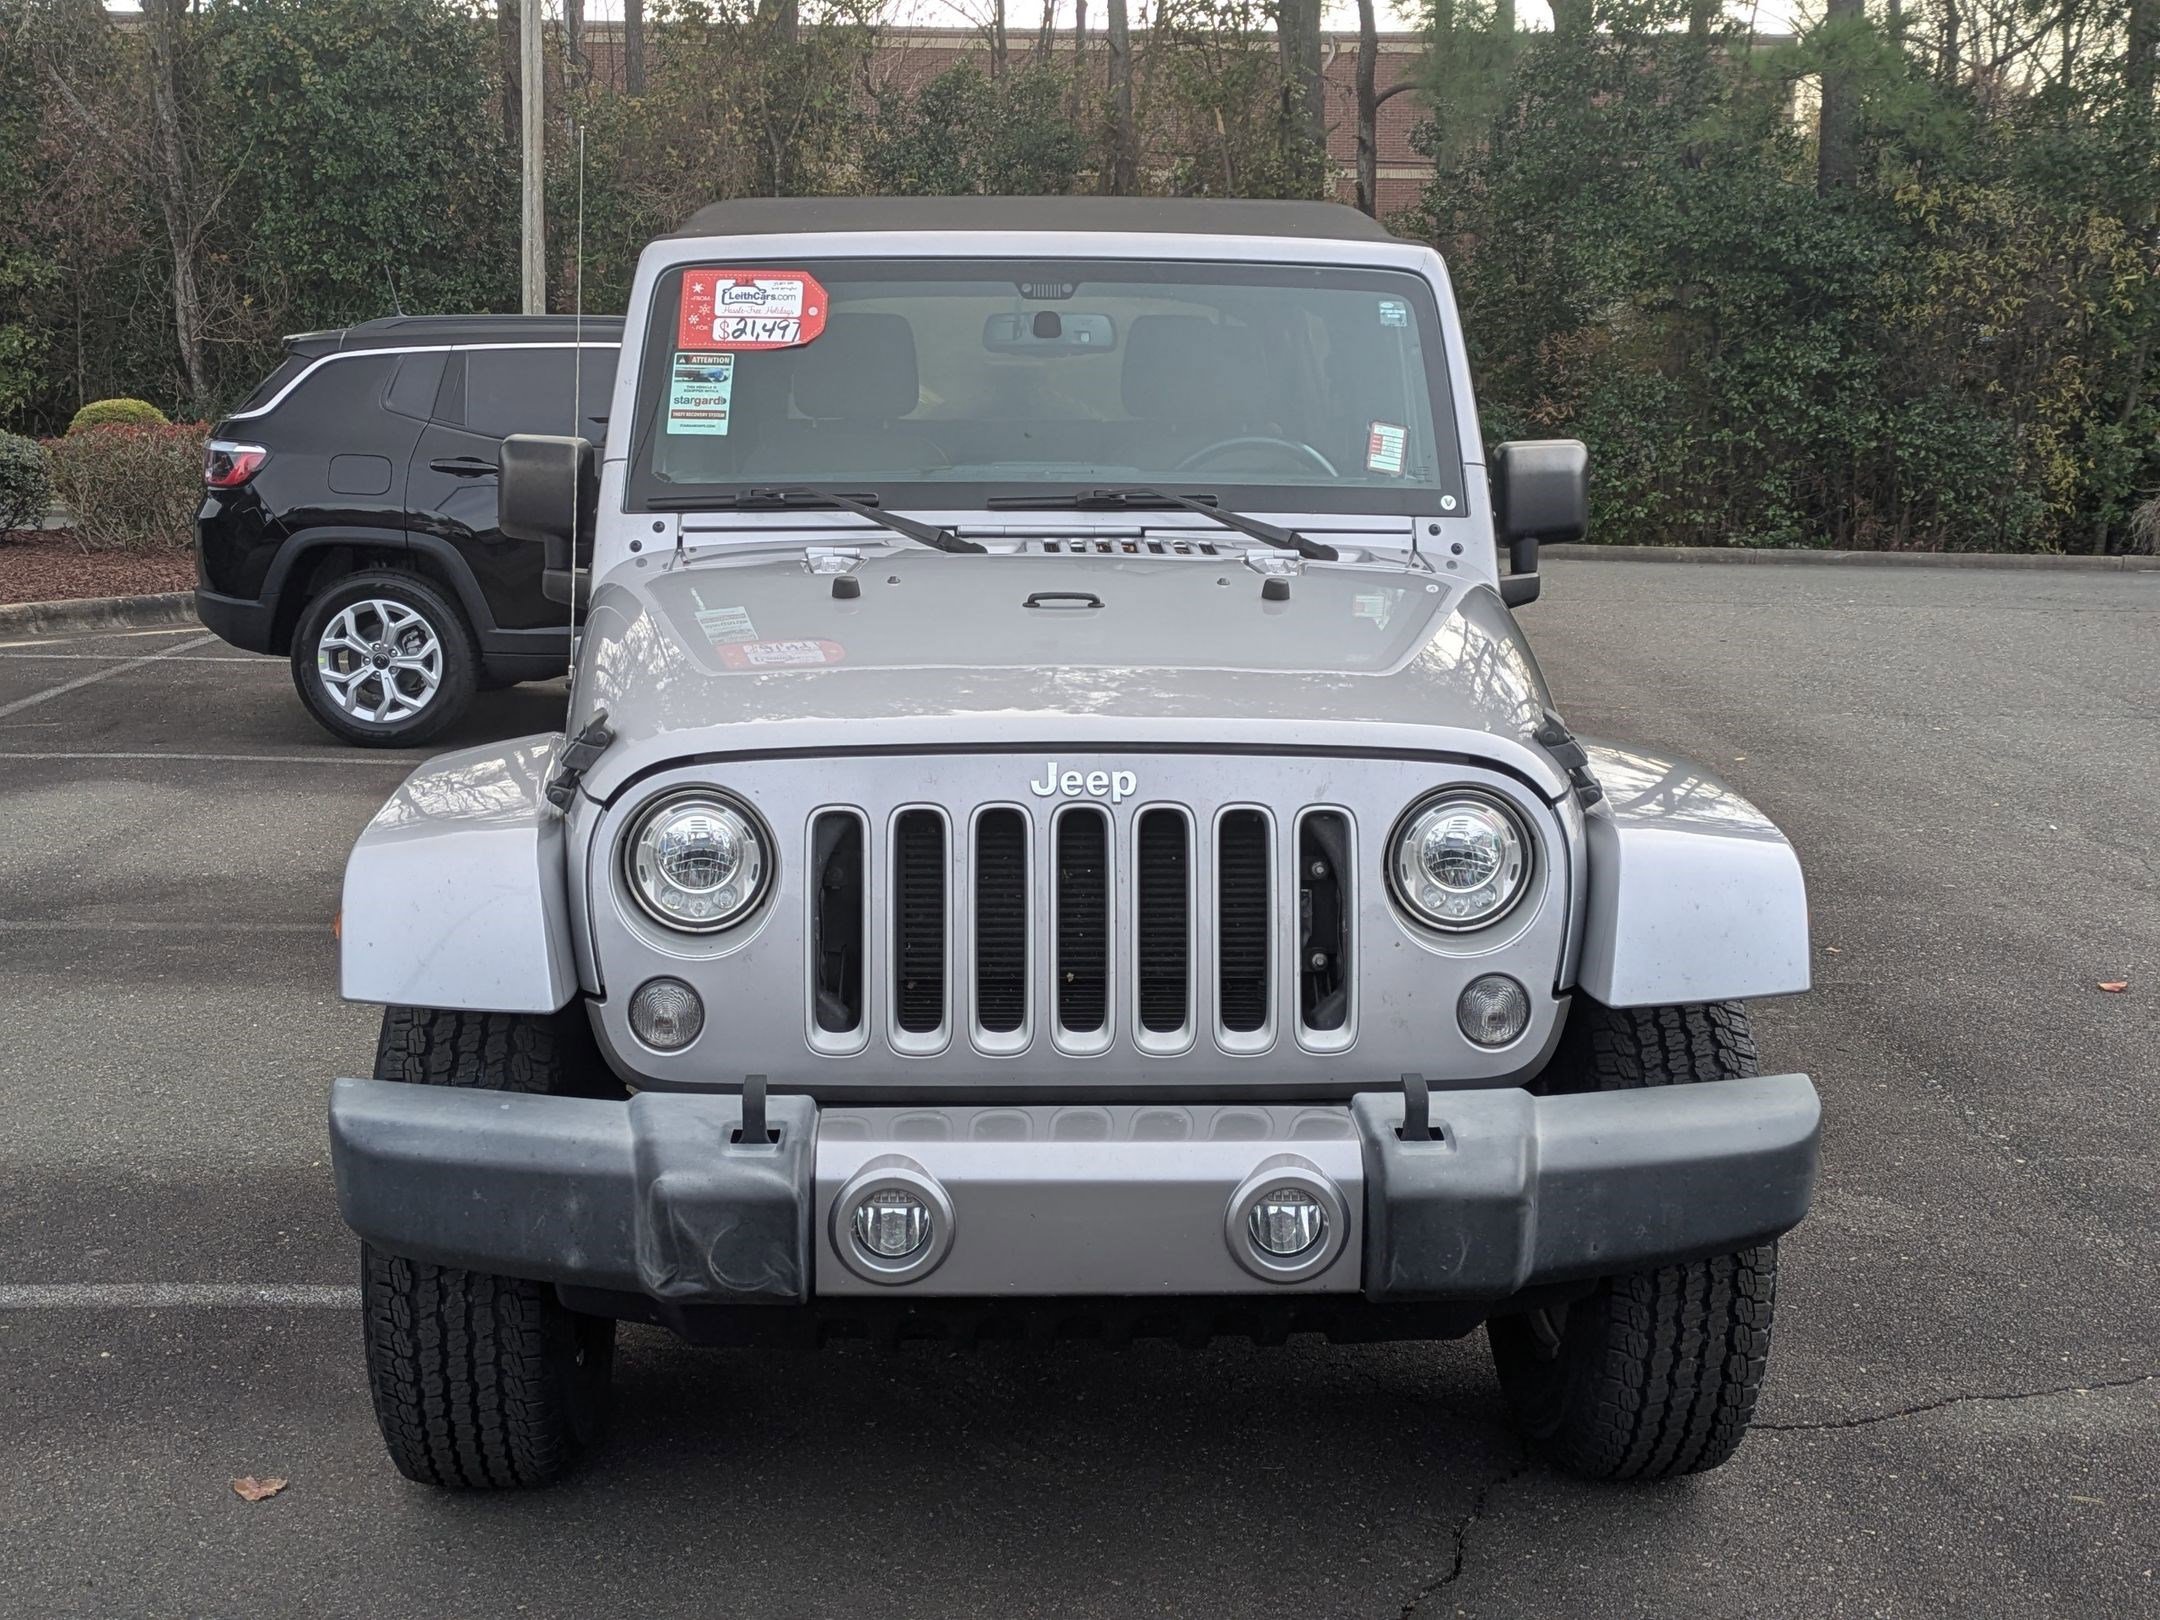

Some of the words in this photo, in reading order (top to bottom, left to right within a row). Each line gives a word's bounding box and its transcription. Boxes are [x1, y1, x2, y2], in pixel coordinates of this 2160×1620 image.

[728, 291, 797, 301] LeithCars.com
[691, 356, 730, 364] ATTENTION
[1030, 761, 1138, 805] Jeep
